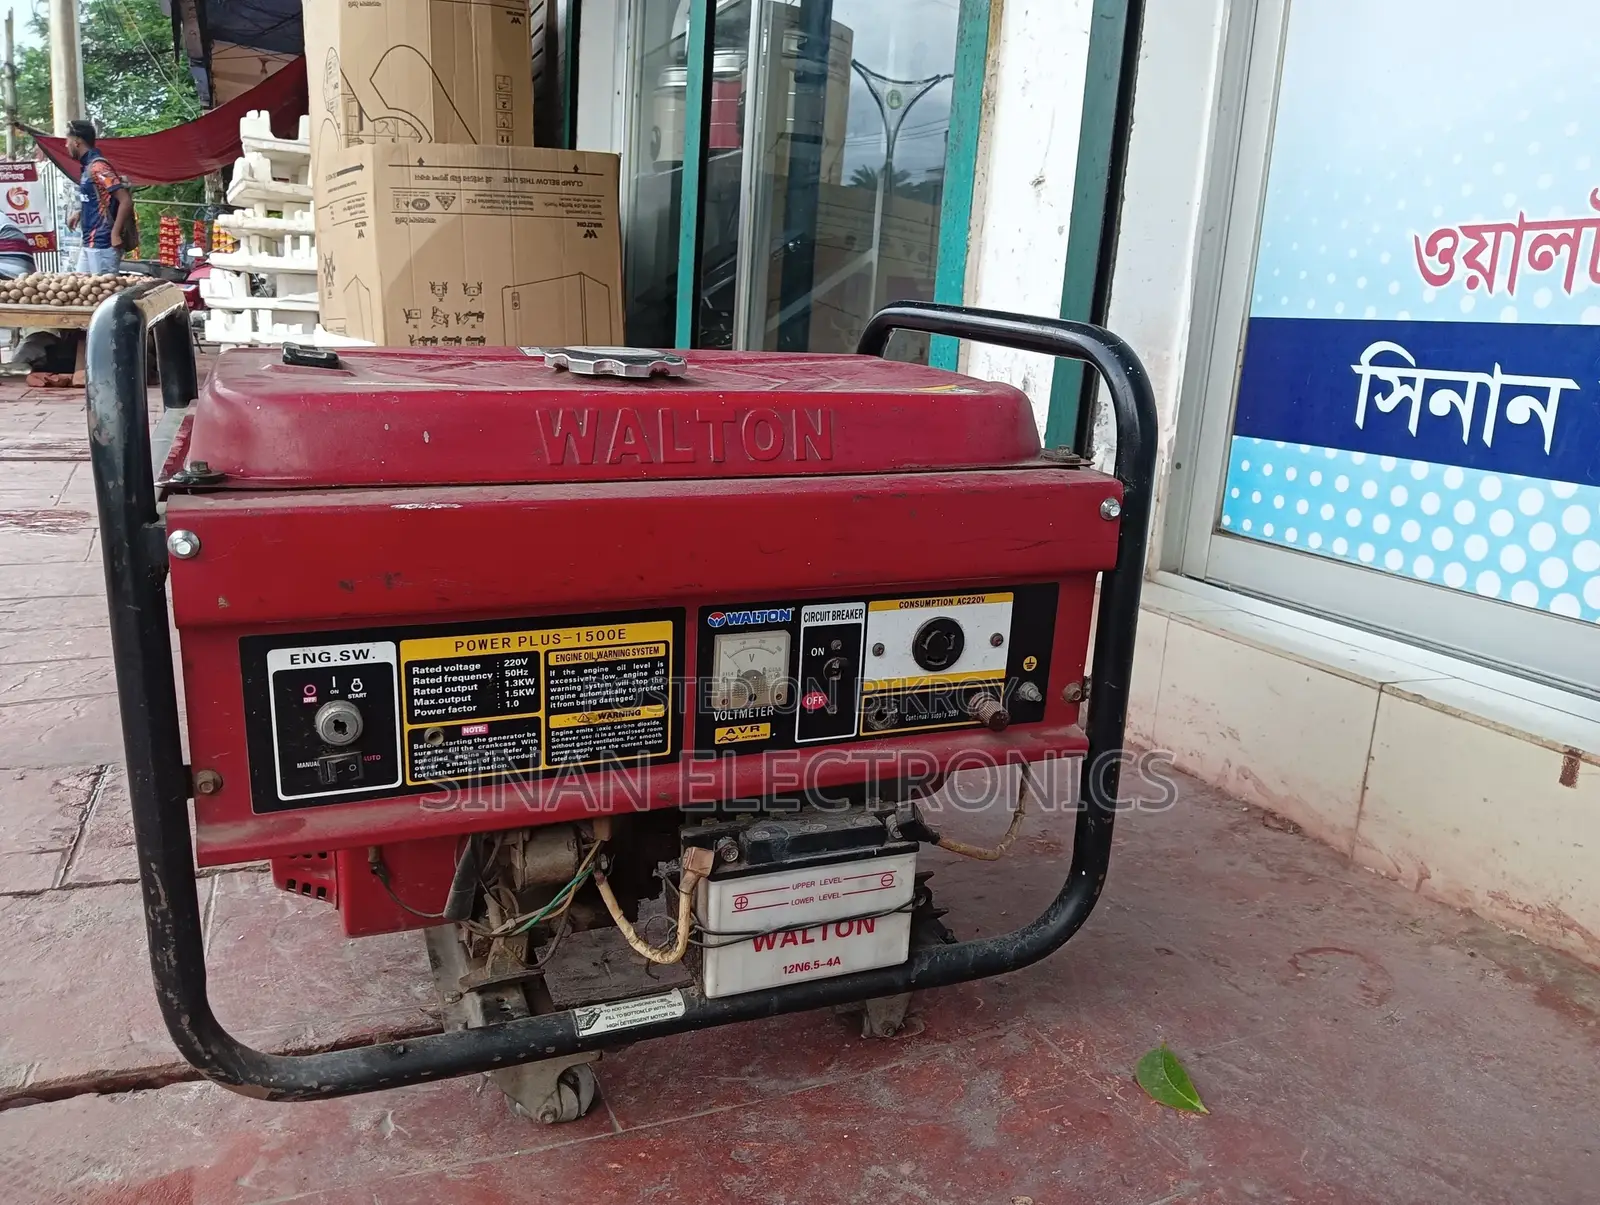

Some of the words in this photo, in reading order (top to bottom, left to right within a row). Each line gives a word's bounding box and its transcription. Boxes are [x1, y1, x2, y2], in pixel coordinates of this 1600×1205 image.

[1350, 340, 1581, 455] সিনান
[536, 407, 833, 466] WALTON
[899, 598, 954, 609] CONSUMPTION
[957, 596, 986, 605] AC220V
[726, 609, 792, 625] WALTON
[804, 610, 831, 622] CIRCUIT
[832, 608, 863, 620] BREAKER
[455, 638, 511, 652] POWER
[811, 647, 825, 656] ON
[290, 649, 376, 665] ENG.SW.
[556, 652, 582, 662] ENGINE
[584, 651, 595, 660] OIL
[597, 649, 630, 659] WARNING
[631, 646, 659, 655] SYSTEM
[749, 654, 755, 662] V
[412, 664, 442, 674] Rated
[444, 663, 480, 672] voltage
[504, 658, 528, 667] 220V
[584, 666, 609, 674] engine
[413, 675, 442, 685] Rated
[444, 672, 493, 683] frequency
[504, 668, 528, 676] 50Hz
[550, 675, 596, 684] excessively
[623, 670, 648, 678] engine
[413, 686, 442, 696] Rated
[444, 684, 478, 694] output
[504, 678, 535, 687] 1.3KW
[550, 684, 582, 693] warning
[585, 681, 612, 690] system
[550, 693, 576, 701] engine
[579, 687, 626, 697] automatically
[637, 684, 664, 693] protect
[414, 694, 472, 706] Max.output
[505, 688, 535, 697] 1.5KW
[576, 698, 597, 706] being
[599, 695, 636, 704] damaged.
[806, 696, 824, 705] OFF
[414, 706, 445, 716] Power
[448, 705, 477, 713] factor
[598, 710, 641, 719] WARNING
[713, 706, 774, 721] VOLTMETER
[905, 713, 929, 721] Continual
[931, 711, 947, 719] supply
[463, 726, 486, 734] NOTE:
[726, 726, 760, 735] AVR
[442, 739, 472, 747] starting
[488, 733, 526, 743] generator
[478, 741, 516, 749] crankcase
[593, 737, 625, 745] ventilation.
[414, 755, 448, 765] specified
[455, 752, 480, 760] engine
[452, 759, 480, 767] manual
[508, 752, 537, 761] product
[792, 880, 816, 890] UPPER
[819, 877, 843, 886] LEVEL
[791, 897, 814, 906] LOWER
[818, 892, 841, 901] LEVEL
[782, 956, 841, 975] 12N6.5-4A
[620, 1017, 649, 1026] DETERGENT
